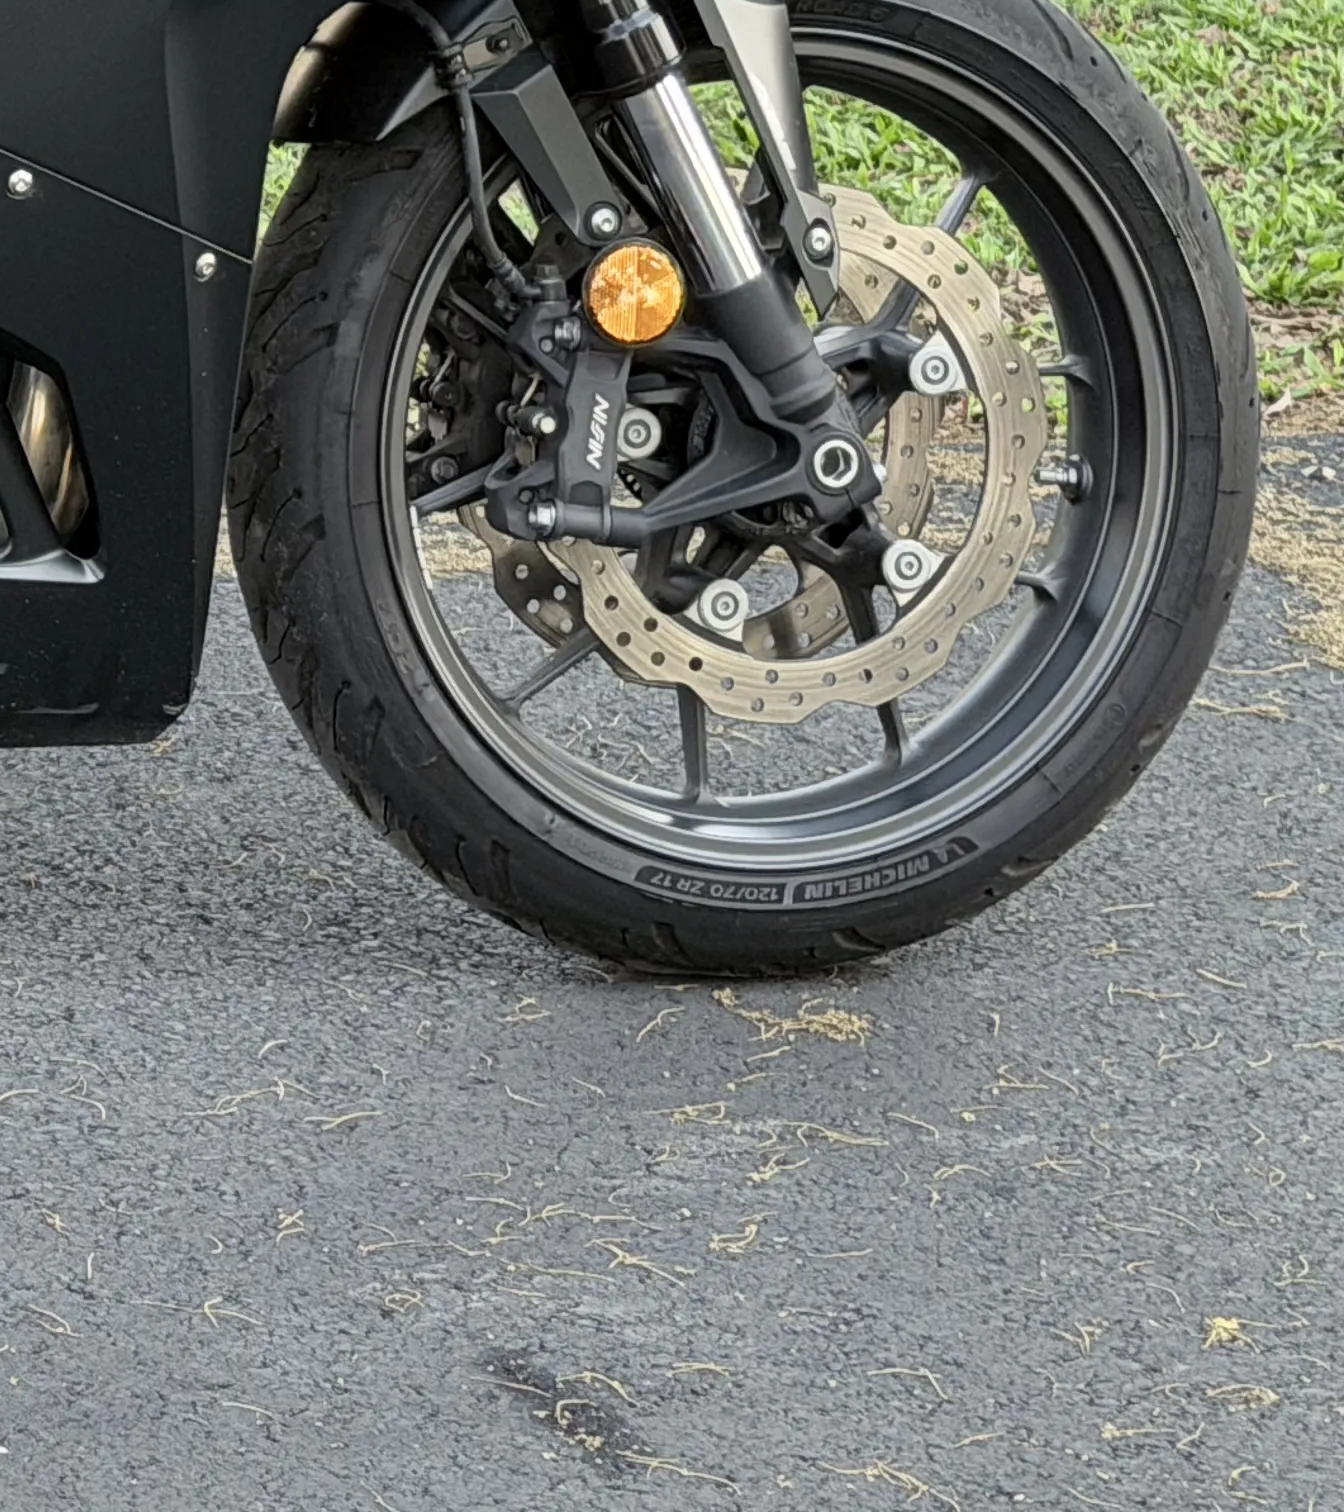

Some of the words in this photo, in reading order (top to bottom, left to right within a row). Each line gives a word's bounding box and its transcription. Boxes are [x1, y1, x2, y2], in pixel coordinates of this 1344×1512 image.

[650, 871, 673, 886] 17
[677, 877, 704, 893] ZR
[804, 854, 930, 901] MICHELIN
[709, 881, 779, 902] 120/70
